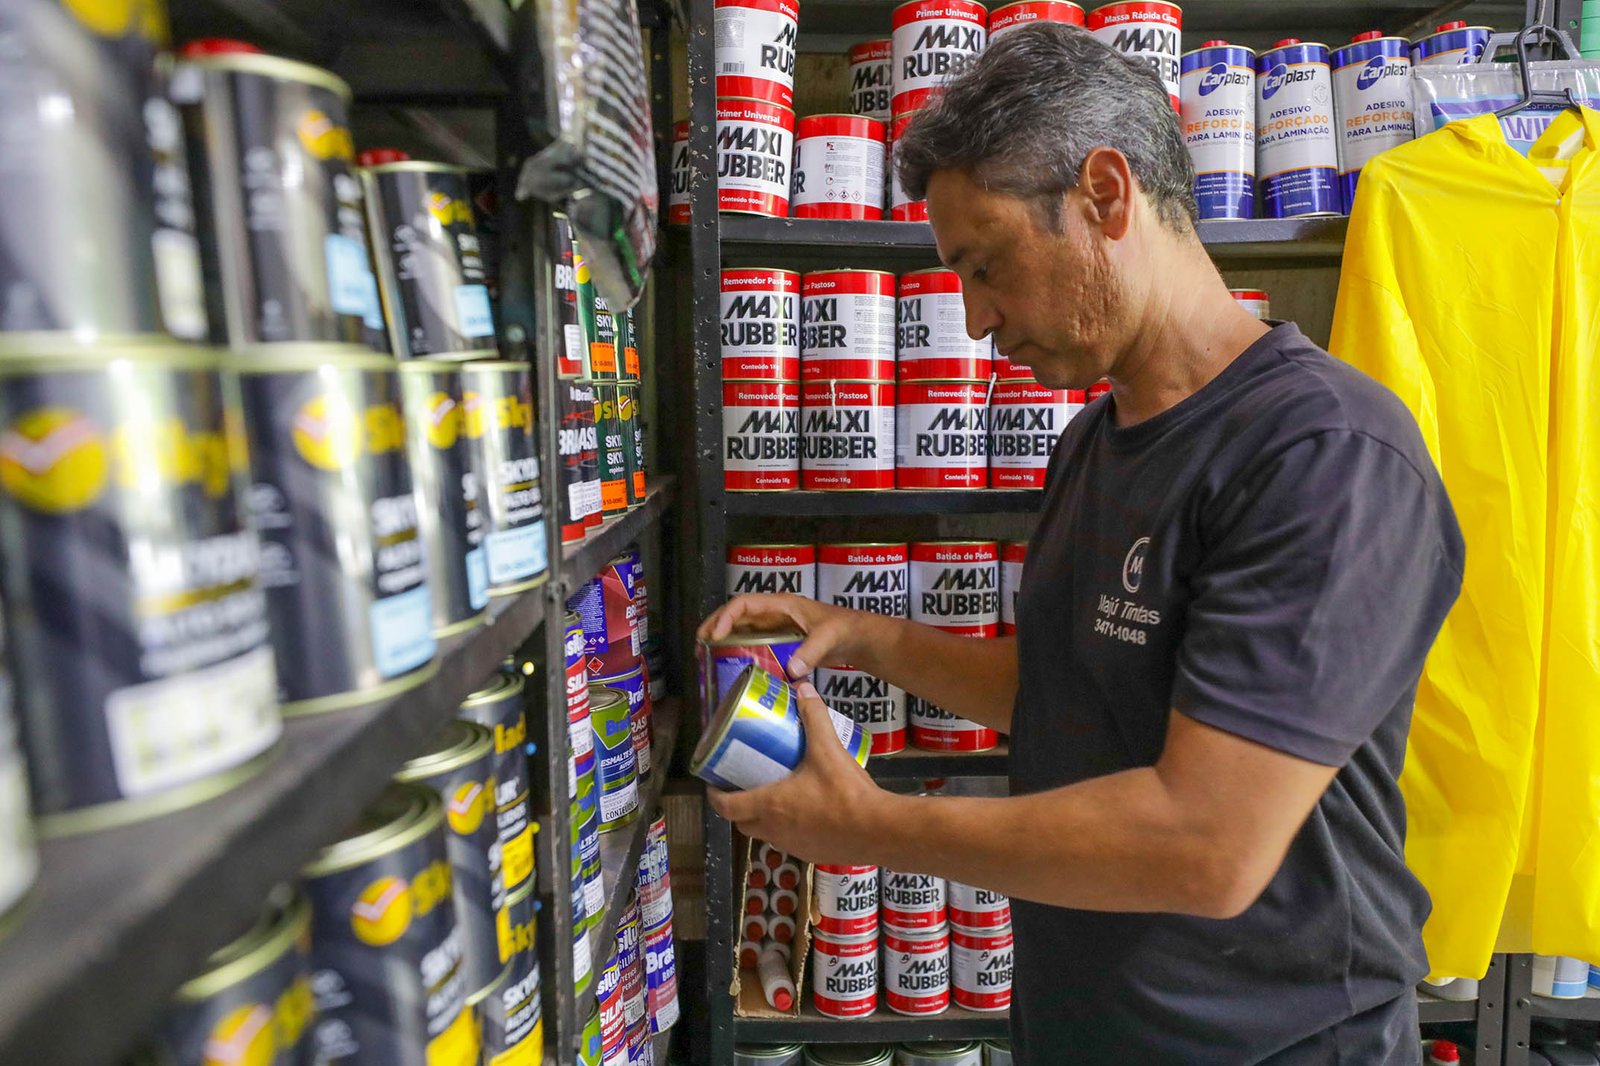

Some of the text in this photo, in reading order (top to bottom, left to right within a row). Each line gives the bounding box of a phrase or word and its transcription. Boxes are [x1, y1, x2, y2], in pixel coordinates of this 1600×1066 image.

[916, 8, 979, 20] Primer Universal
[1014, 12, 1037, 21] Cinza
[1104, 11, 1178, 24] Massa Rápida Cinza
[912, 24, 980, 52] MAXI
[1112, 28, 1176, 56] MAXI
[1202, 69, 1250, 87] Carplast
[1265, 68, 1316, 90] Carplast
[1361, 64, 1408, 80] Carplast
[1270, 106, 1311, 119] ADESIVO
[1366, 101, 1405, 111] ADESIVO
[744, 110, 780, 123] Universal
[1257, 115, 1329, 135] REFORÇADO
[717, 126, 782, 157] MAXI
[1187, 133, 1210, 143] PARA
[1278, 126, 1330, 140] LAMINAÇÃO
[1347, 128, 1371, 138] PARA
[718, 153, 785, 186] UBBER
[723, 277, 766, 286] Removedor
[811, 281, 836, 289] Pastoso
[724, 295, 793, 320] MAXI
[802, 298, 837, 322] AXI
[721, 322, 797, 346] RUBBER
[802, 325, 847, 350] BBER
[738, 410, 799, 433] MAXI
[805, 410, 870, 433] MAXI
[992, 408, 1054, 431] MAXI
[800, 436, 877, 459] RUBBER
[840, 477, 851, 485] 1Kg
[737, 555, 797, 563] Batida de Pedra
[848, 554, 873, 562] Batida
[936, 552, 961, 560] Batida
[975, 552, 992, 560] Pedra
[734, 571, 802, 593] MAXI
[843, 569, 905, 593] MAXI
[931, 567, 995, 590] MAXI
[922, 592, 998, 616] RUBBER
[1120, 601, 1161, 625] Tintas
[1094, 618, 1147, 646] 3471-1048
[823, 675, 889, 698] MAXI
[889, 875, 934, 889] MAXI
[884, 887, 939, 905] RUBBER
[833, 958, 876, 977] MAXI
[905, 954, 947, 974] MAXI
